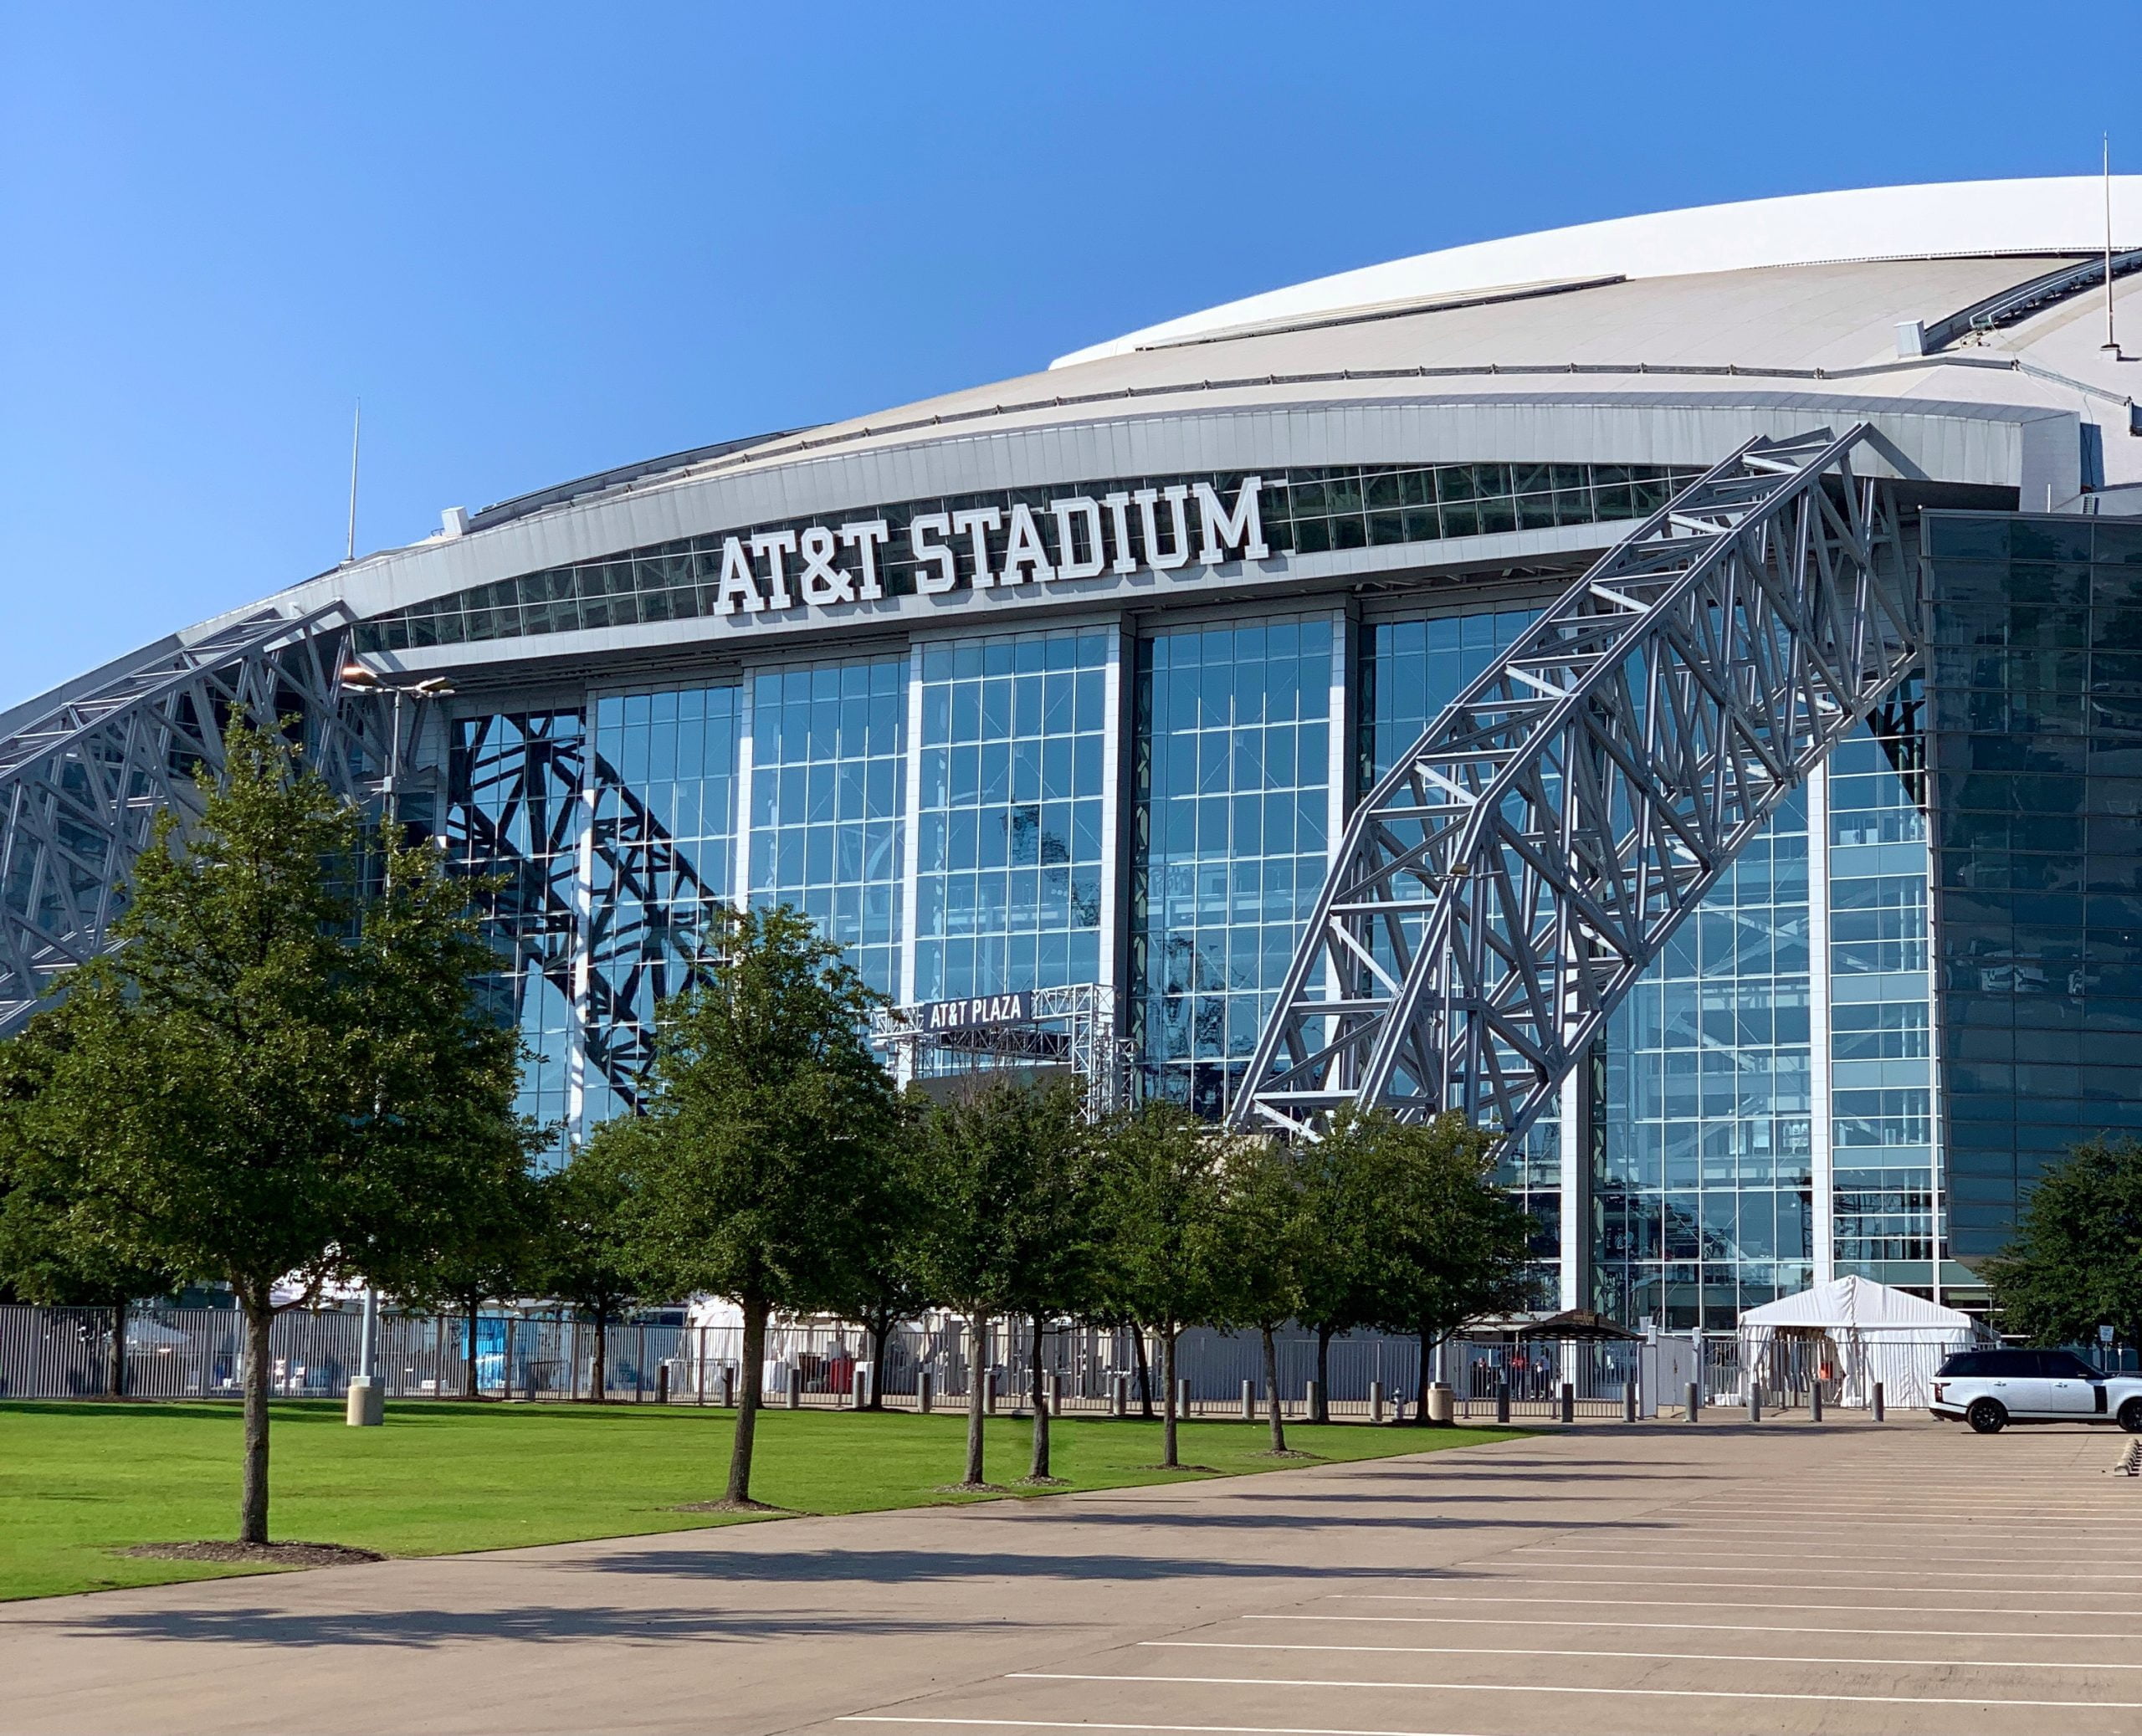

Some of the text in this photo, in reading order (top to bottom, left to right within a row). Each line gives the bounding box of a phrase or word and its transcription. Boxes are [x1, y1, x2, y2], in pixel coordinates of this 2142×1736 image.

[714, 477, 1269, 616] AT&T STADIUM
[930, 995, 1021, 1028] AT&T PLAZA
